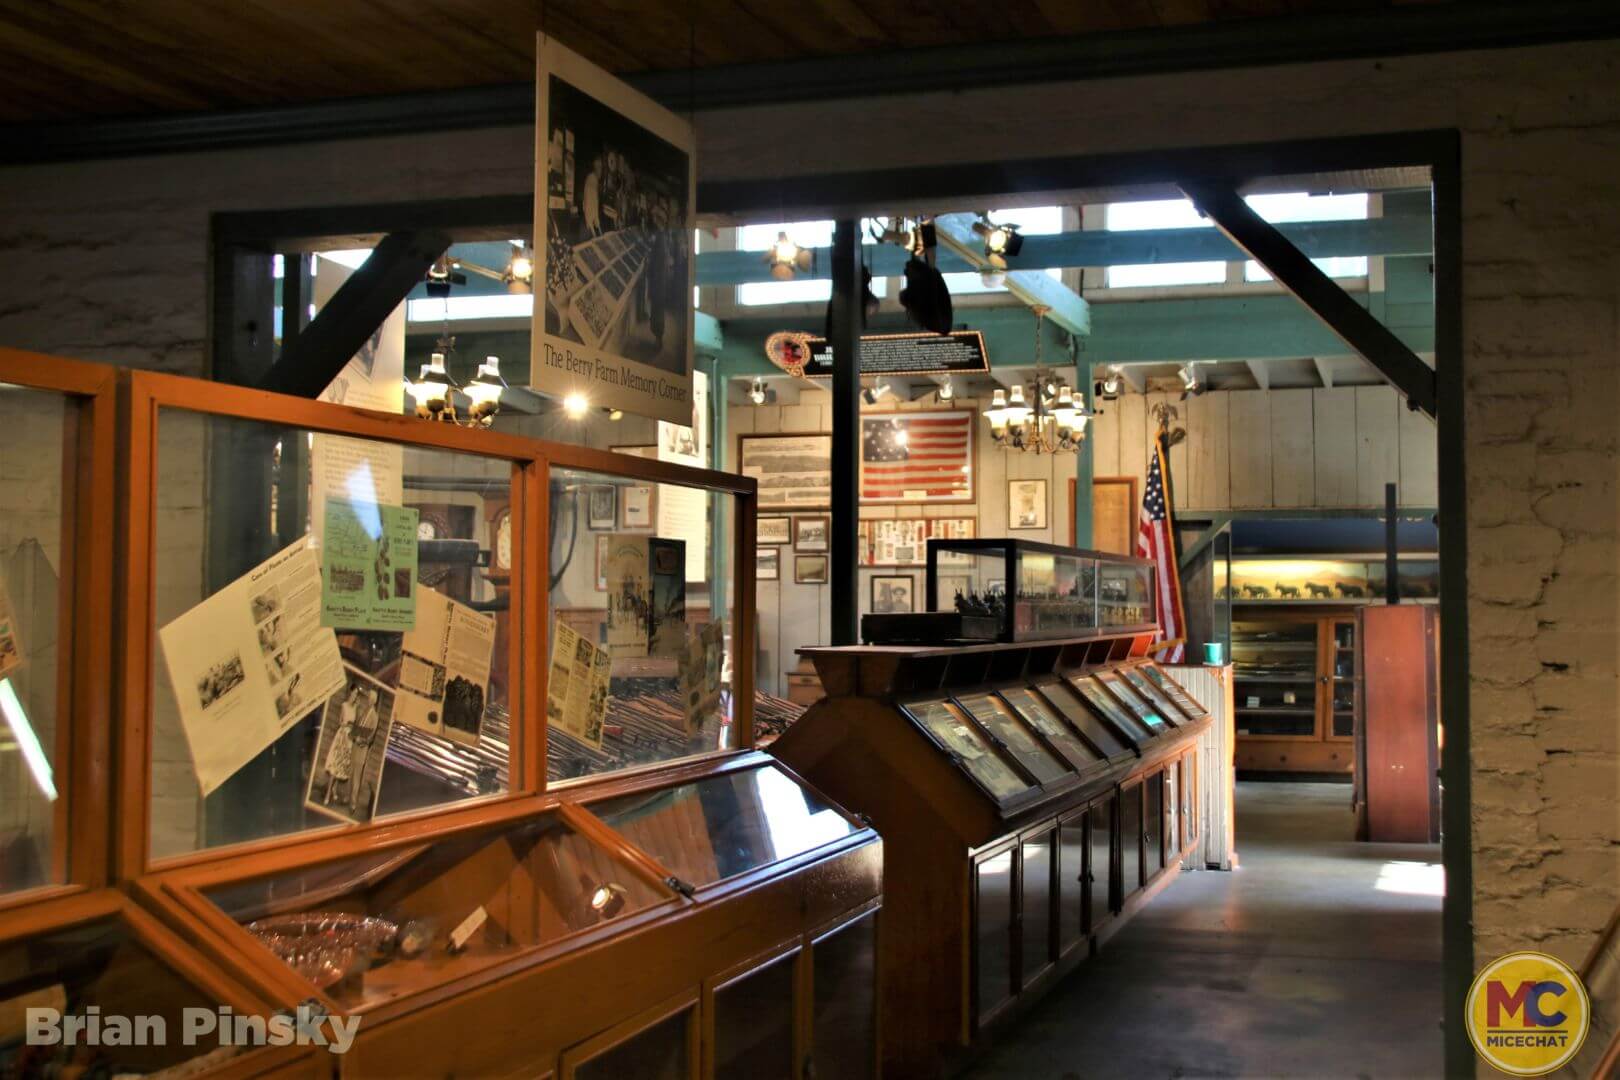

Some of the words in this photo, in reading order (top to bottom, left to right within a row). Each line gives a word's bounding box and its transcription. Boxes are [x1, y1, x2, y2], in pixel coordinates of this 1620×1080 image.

[543, 343, 563, 368] The
[566, 350, 593, 380] Berry
[595, 358, 619, 384] Farm
[620, 366, 657, 394] Memory
[658, 378, 687, 401] Corner
